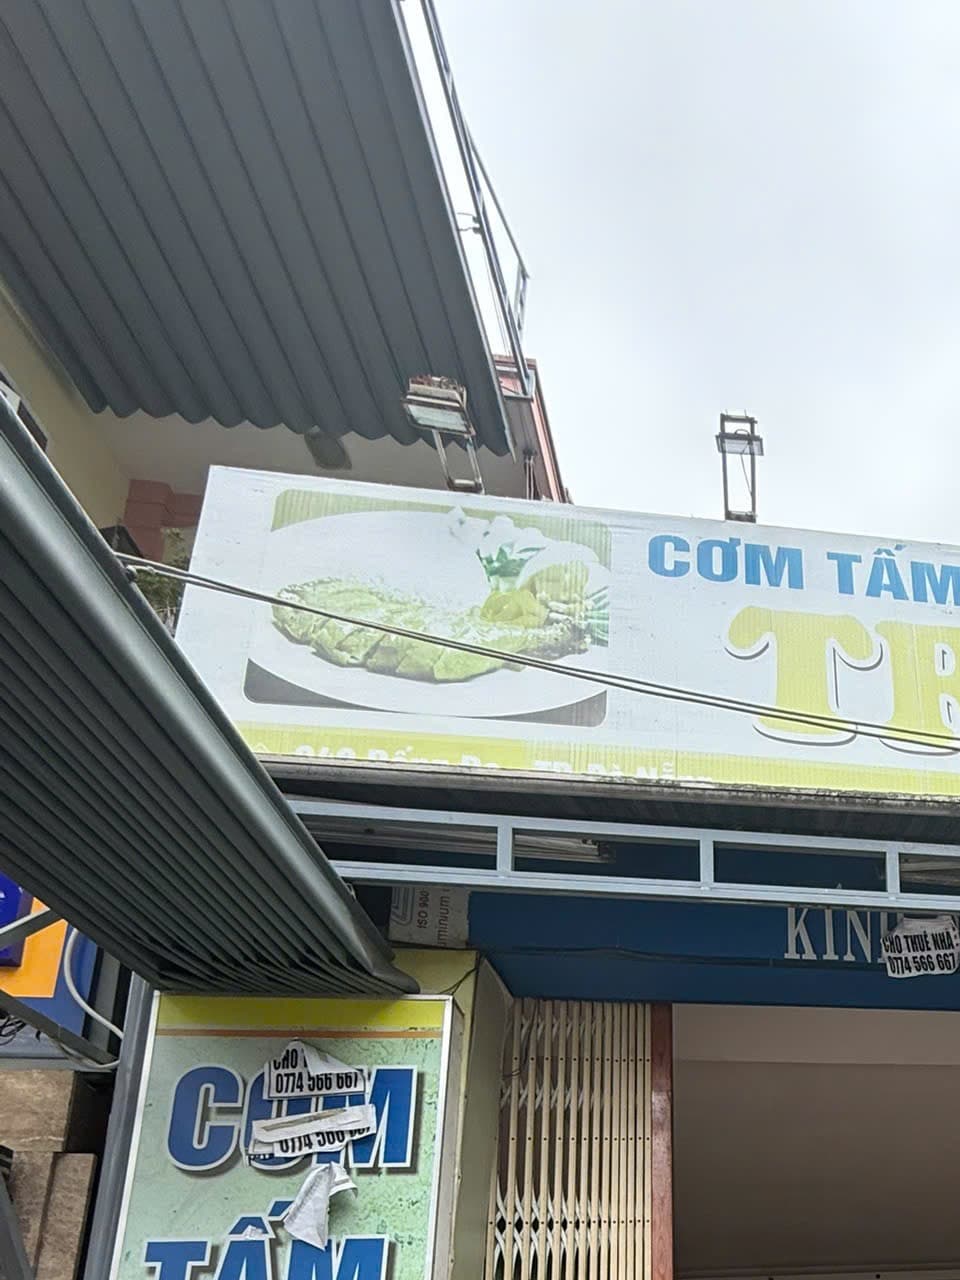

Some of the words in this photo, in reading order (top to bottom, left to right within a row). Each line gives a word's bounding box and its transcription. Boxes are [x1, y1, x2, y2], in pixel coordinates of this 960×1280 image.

[648, 534, 804, 590] CƠM
[418, 888, 430, 908] 900
[888, 955, 912, 975] 0774
[912, 954, 936, 973] 566
[936, 953, 956, 971] 667
[276, 1072, 304, 1093] 0774
